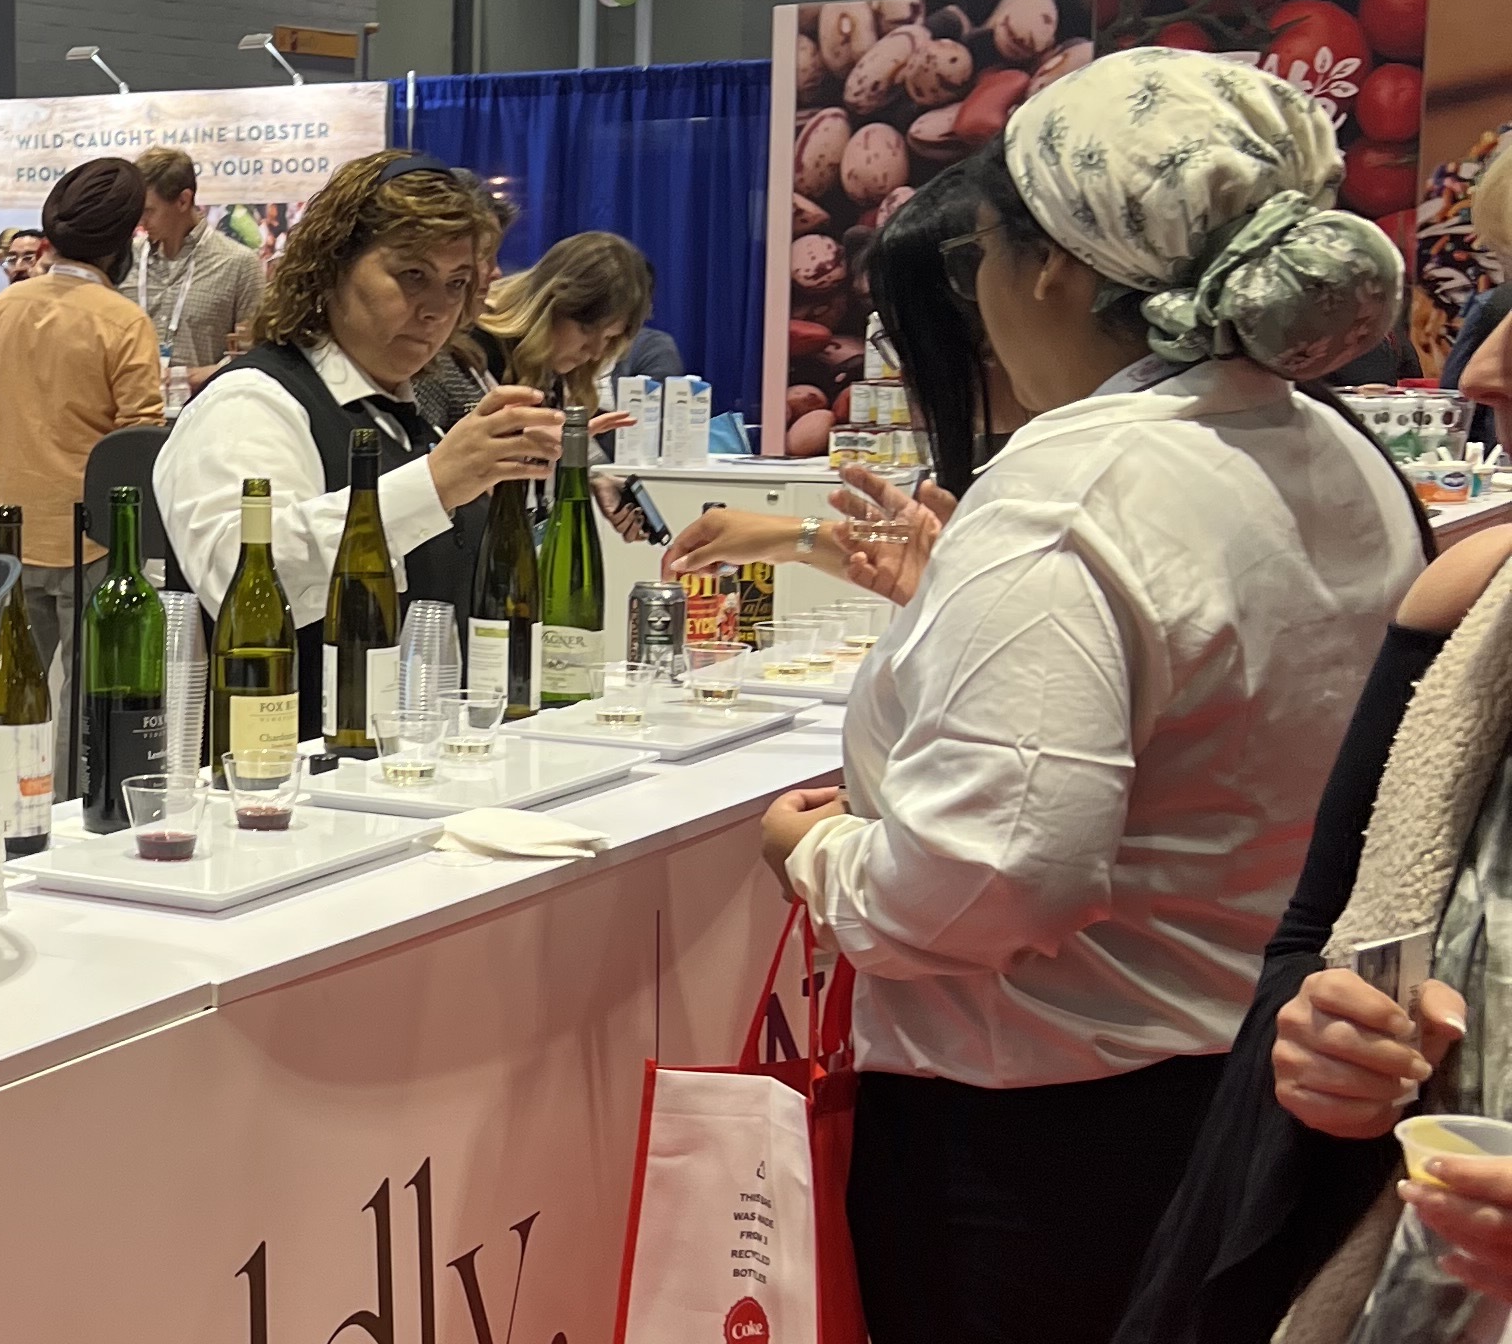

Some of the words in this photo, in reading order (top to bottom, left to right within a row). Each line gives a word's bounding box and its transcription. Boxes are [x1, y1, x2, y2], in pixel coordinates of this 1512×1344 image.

[15, 129, 155, 150] WILD-CAUGHT
[162, 126, 227, 145] MAINE
[234, 122, 331, 142] LOBSTER
[15, 166, 66, 183] FROM
[210, 159, 263, 177] YOUR
[271, 156, 330, 175] DOOR
[259, 701, 284, 713] FOX
[143, 715, 165, 729] FOX
[733, 1211, 756, 1222] WAS
[739, 1230, 762, 1242] FROM
[730, 1248, 771, 1267] RECYCLED
[732, 1268, 767, 1285] BOTTLES
[731, 1320, 764, 1341] Coke
